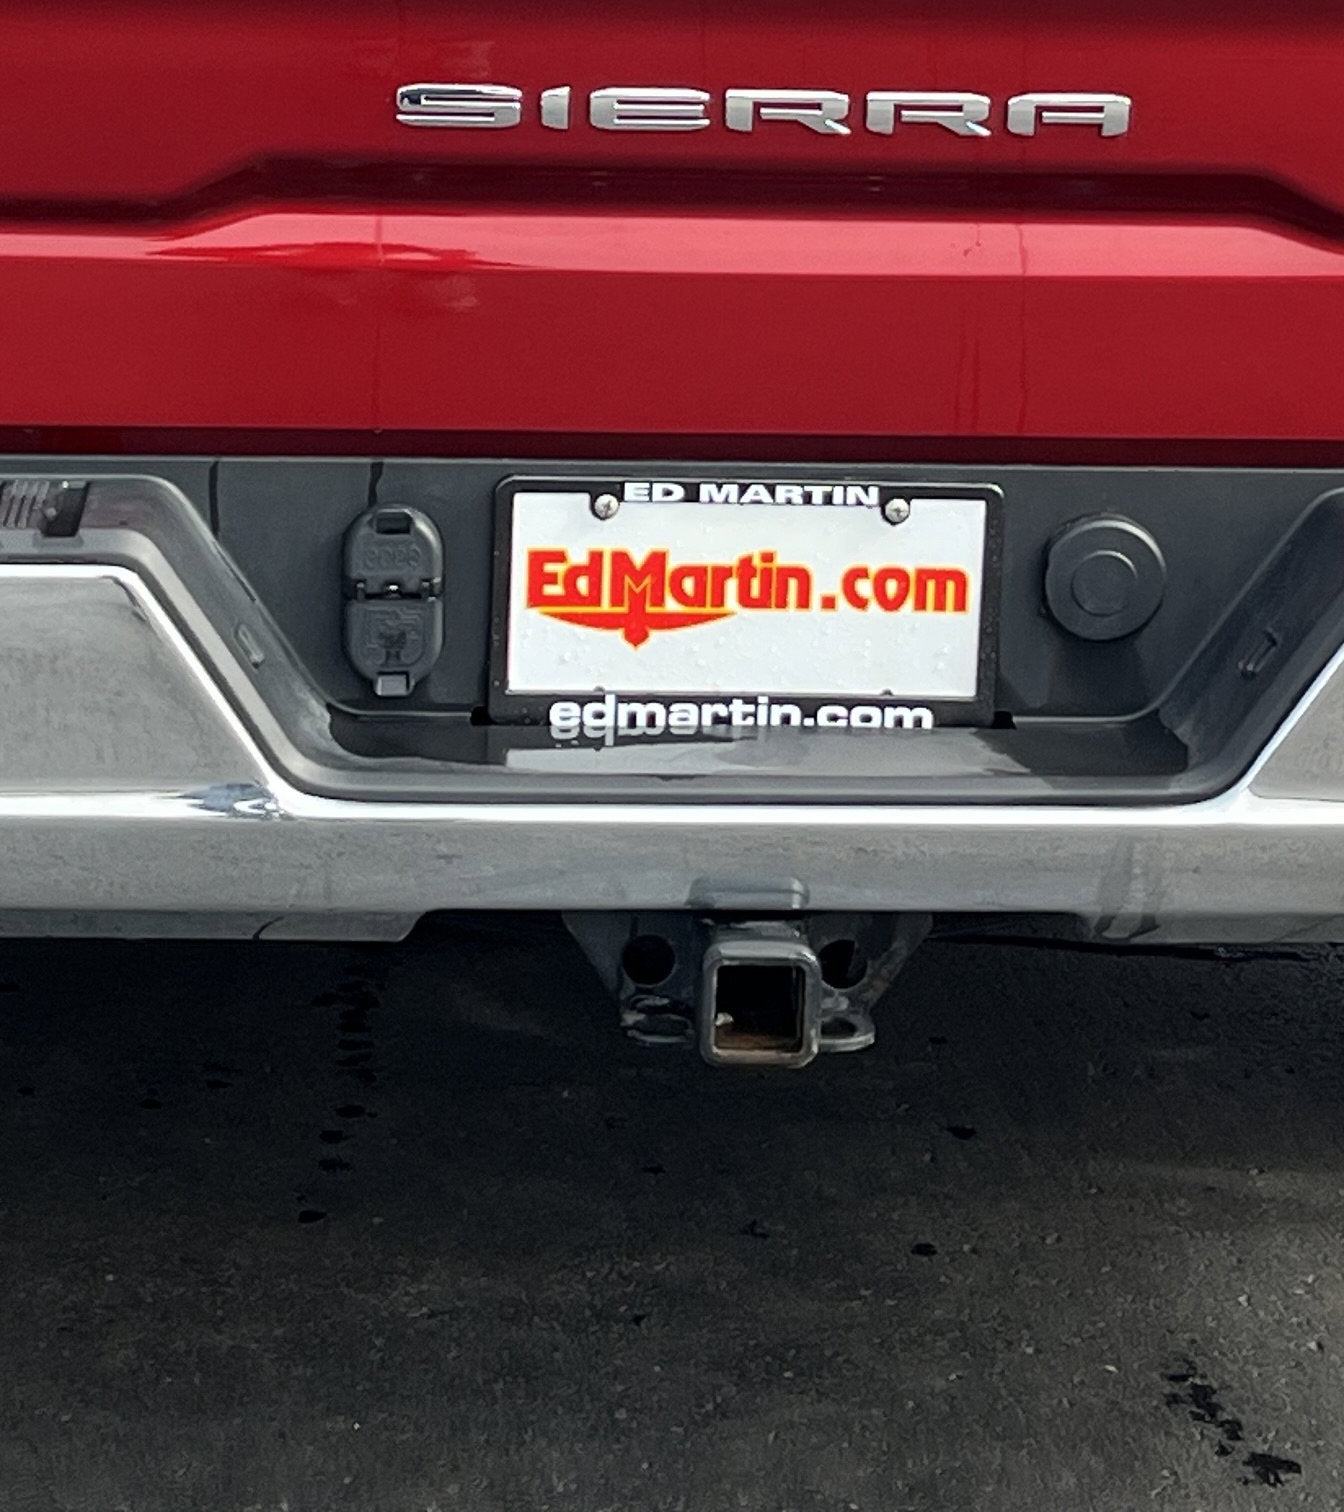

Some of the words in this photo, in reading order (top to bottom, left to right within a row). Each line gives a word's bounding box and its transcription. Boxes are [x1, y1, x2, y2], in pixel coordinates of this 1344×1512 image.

[396, 82, 1133, 138] SIERRA
[622, 481, 687, 503] ED
[698, 482, 881, 507] MARTIN
[525, 546, 970, 616] EdMartin.com
[549, 694, 934, 731] edmartin.com
